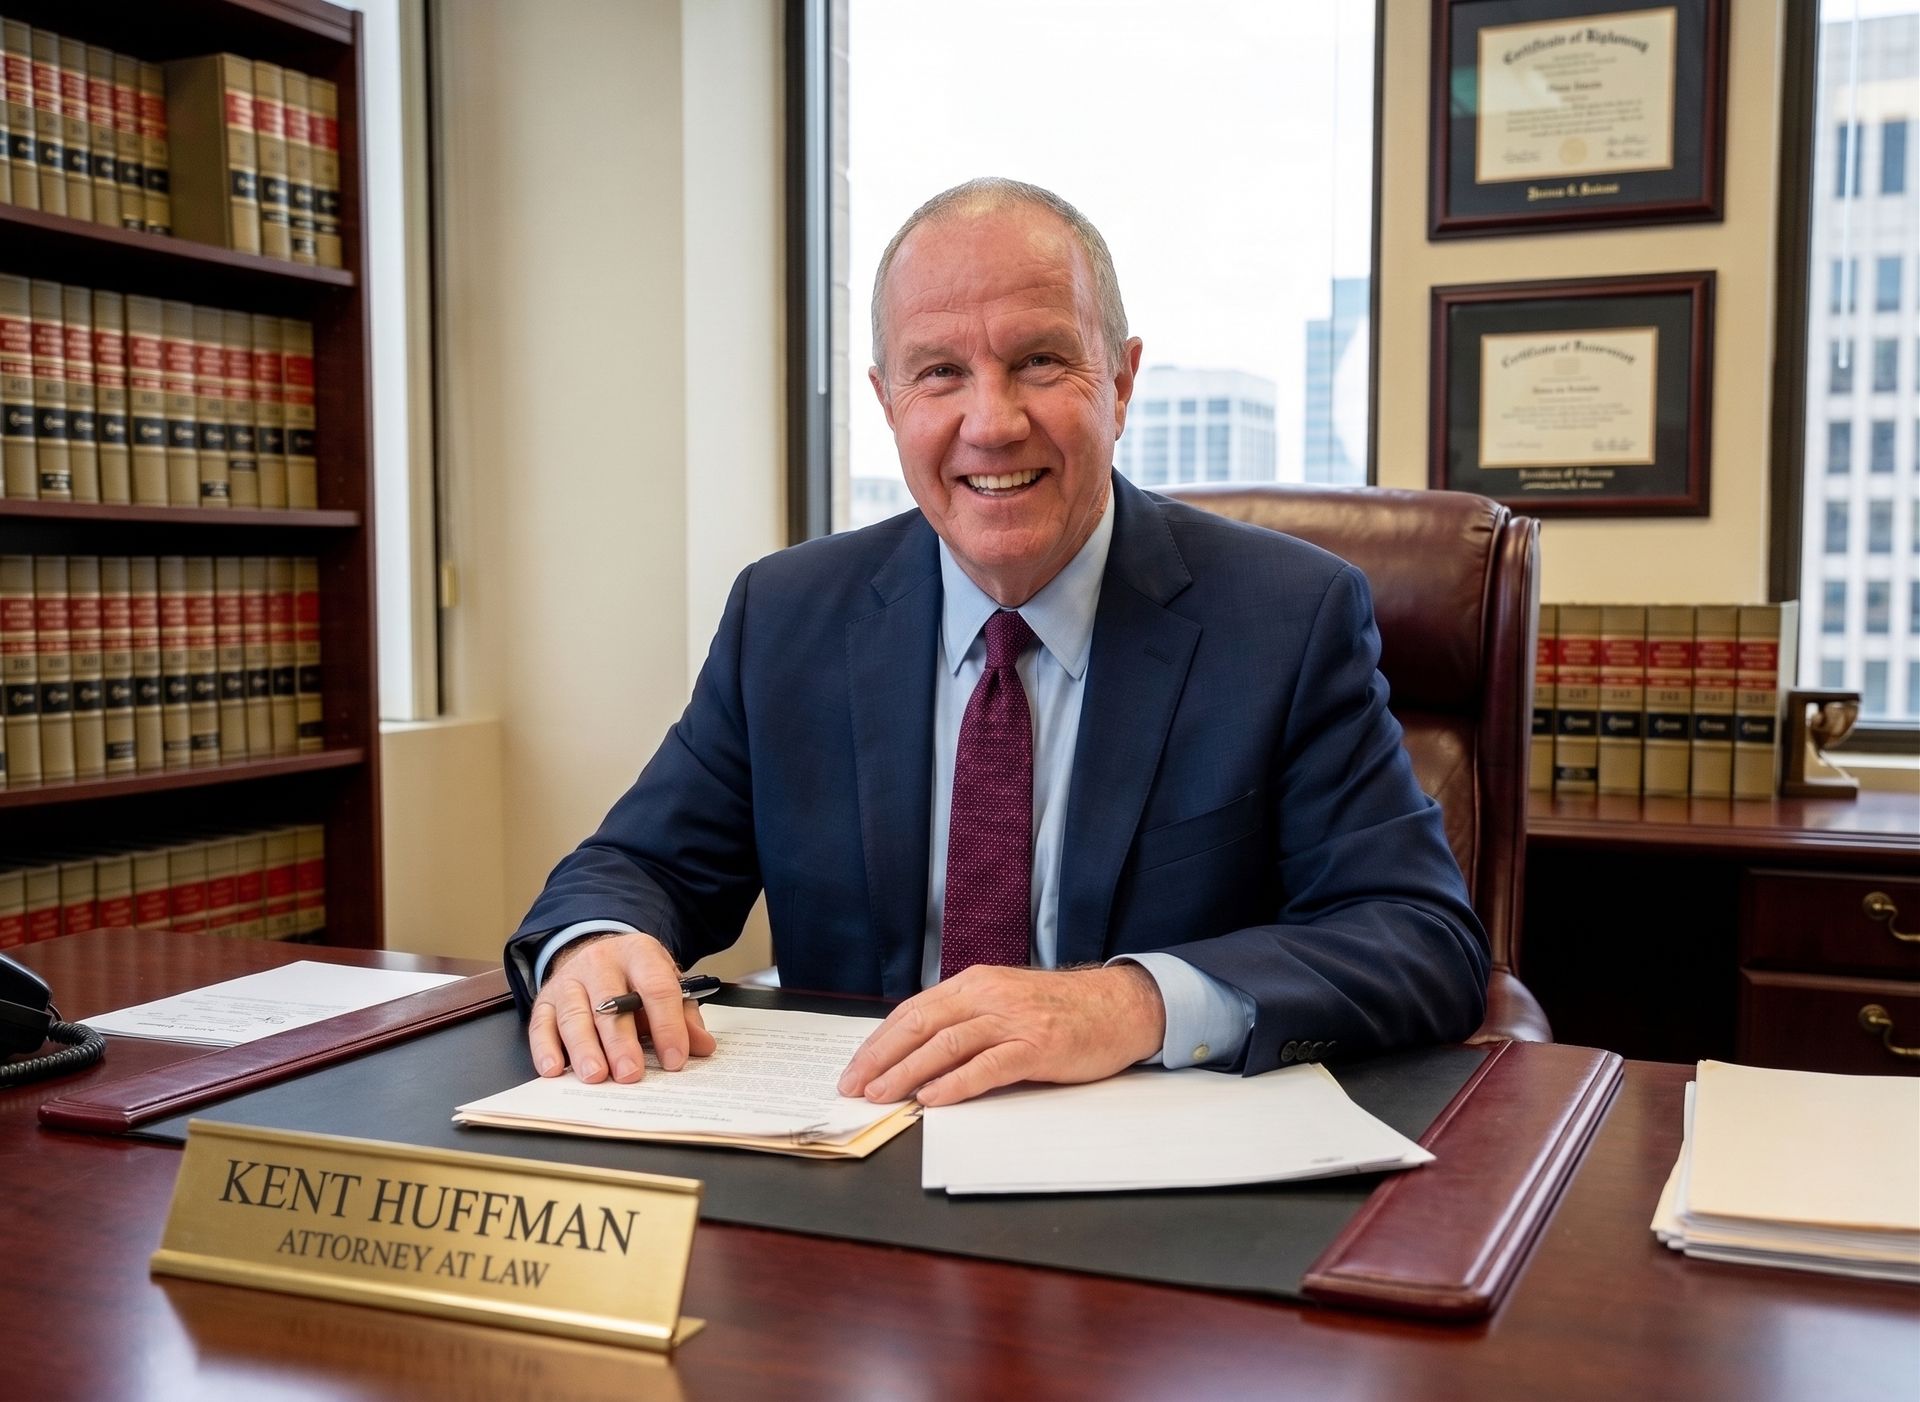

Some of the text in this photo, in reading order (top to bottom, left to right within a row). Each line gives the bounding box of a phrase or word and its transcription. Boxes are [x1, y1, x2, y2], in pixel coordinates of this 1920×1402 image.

[1570, 29, 1583, 44] of
[218, 1159, 641, 1256] KENT HUFFMAN
[277, 1229, 551, 1289] ATTORNEY AT LAW
